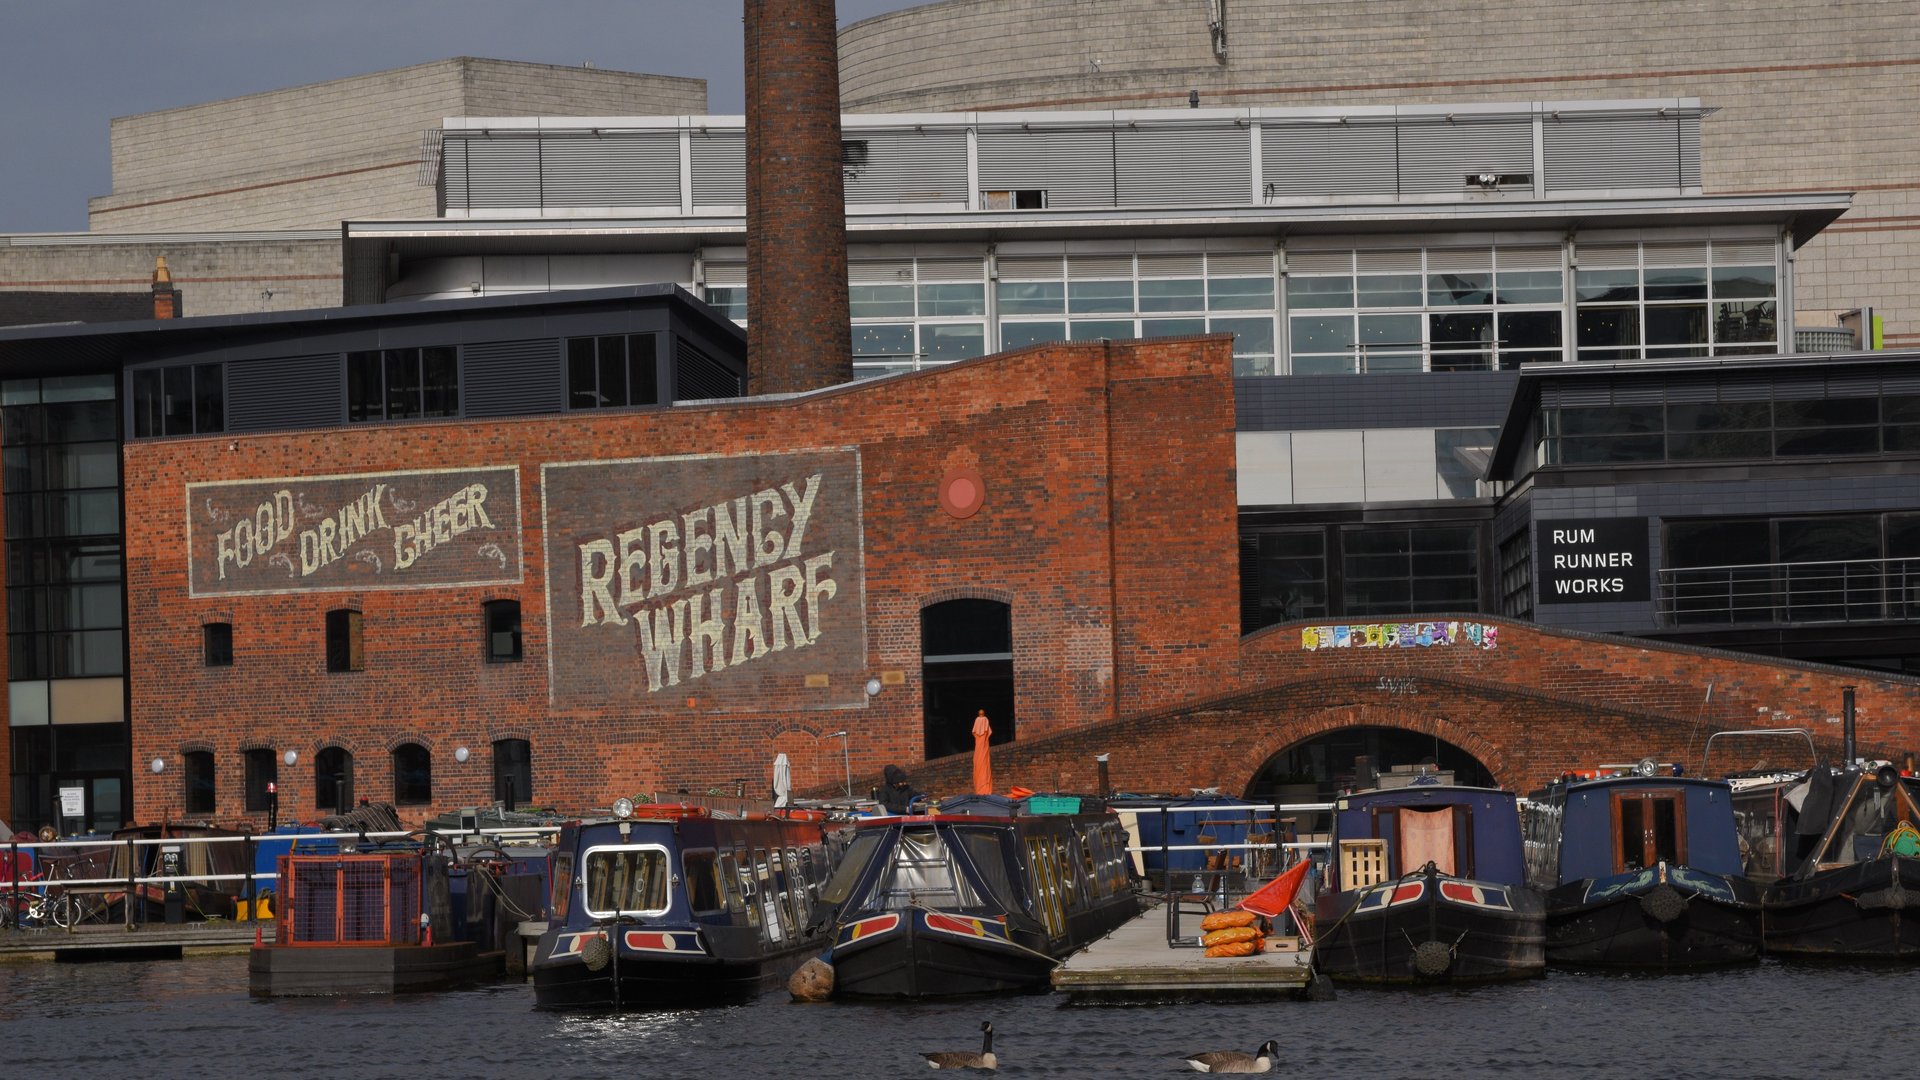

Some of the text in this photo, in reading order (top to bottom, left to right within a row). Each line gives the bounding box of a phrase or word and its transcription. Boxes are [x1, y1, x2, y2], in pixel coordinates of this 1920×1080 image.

[216, 483, 496, 581] FOOD DRINK CHEER
[578, 473, 822, 628] REGENCY
[1553, 528, 1595, 545] RUM
[1554, 552, 1633, 569] RUNNER
[1555, 578, 1624, 594] WORKS
[633, 550, 838, 693] WHARF
